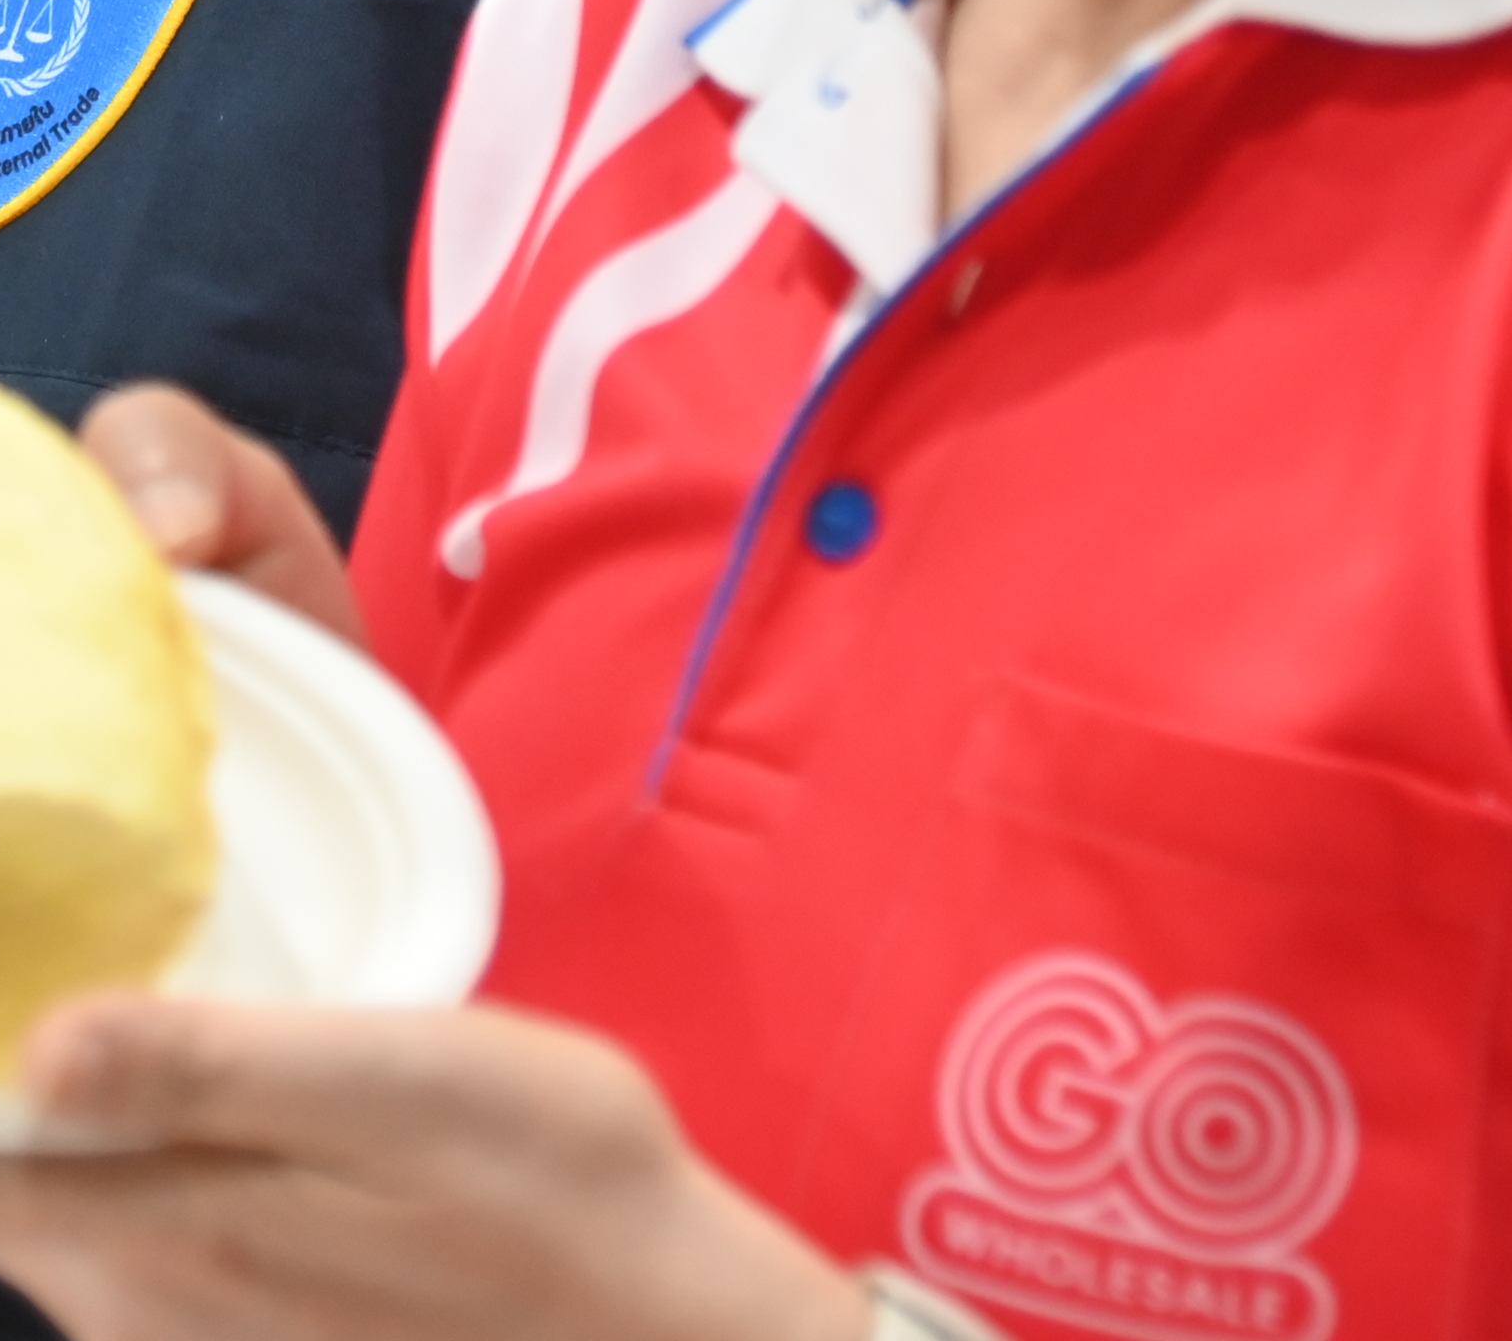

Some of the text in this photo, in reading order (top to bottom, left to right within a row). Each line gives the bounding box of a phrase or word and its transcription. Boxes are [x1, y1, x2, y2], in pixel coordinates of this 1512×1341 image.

[49, 87, 101, 142] Trade
[938, 949, 1358, 1262] GO
[938, 1209, 1284, 1332] WHOLESALE
